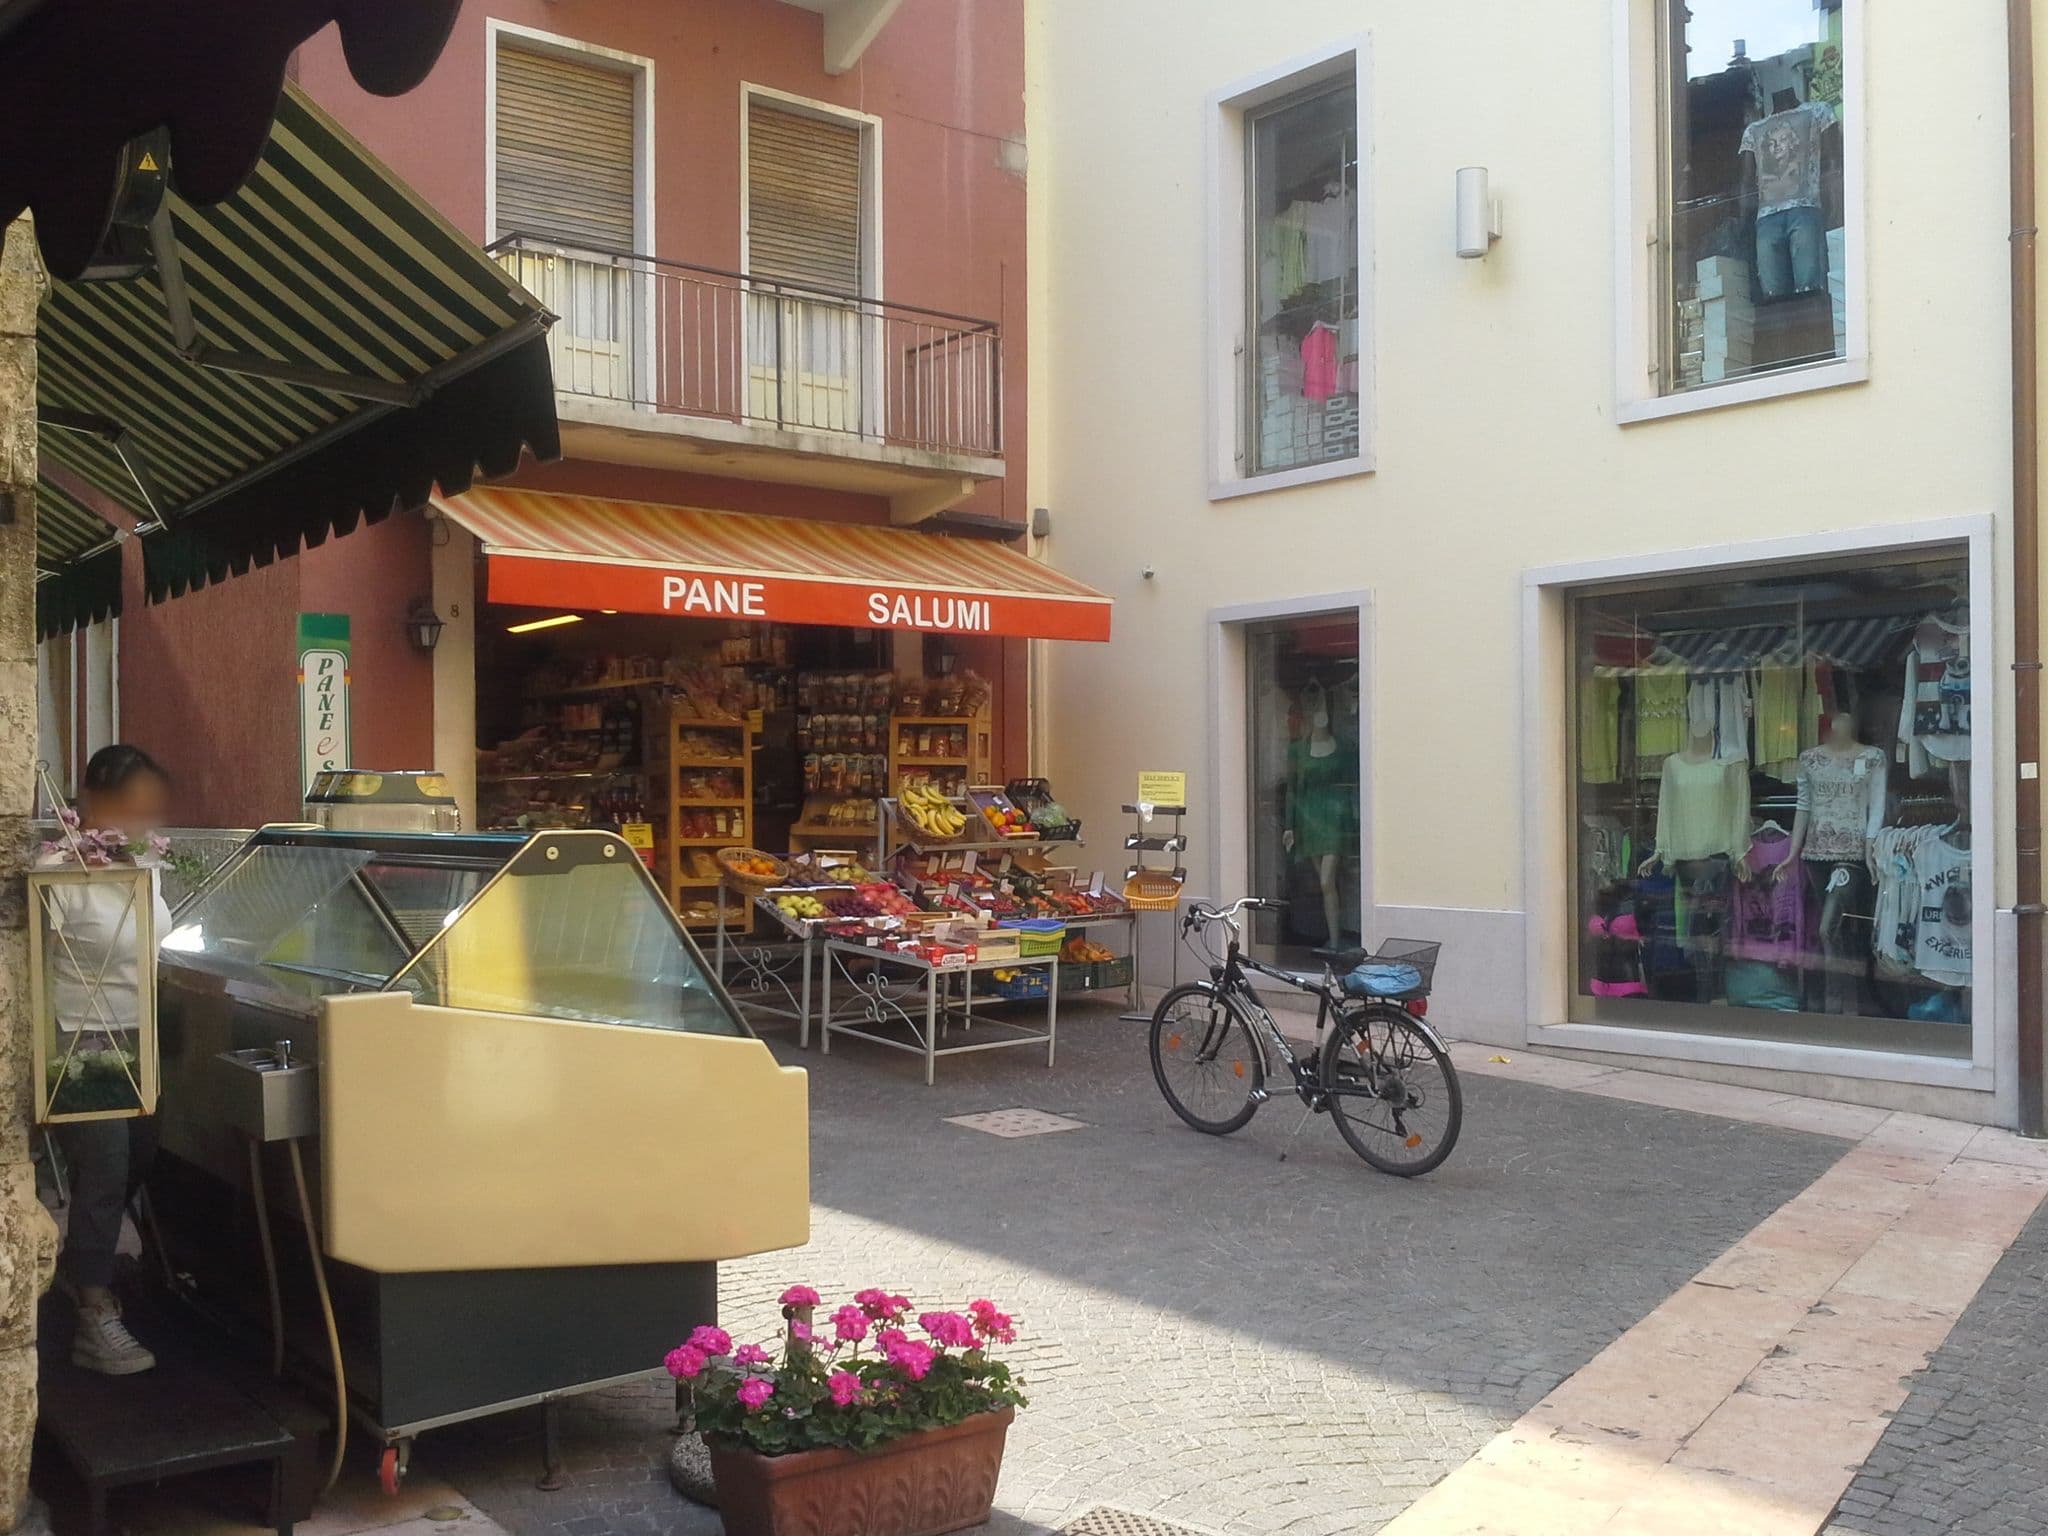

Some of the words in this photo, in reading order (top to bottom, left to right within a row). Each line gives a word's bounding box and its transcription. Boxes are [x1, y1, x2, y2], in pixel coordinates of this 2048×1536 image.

[450, 604, 460, 618] 8
[663, 576, 766, 615] PANE
[868, 592, 990, 631] SALUMI
[316, 658, 335, 730] PANE
